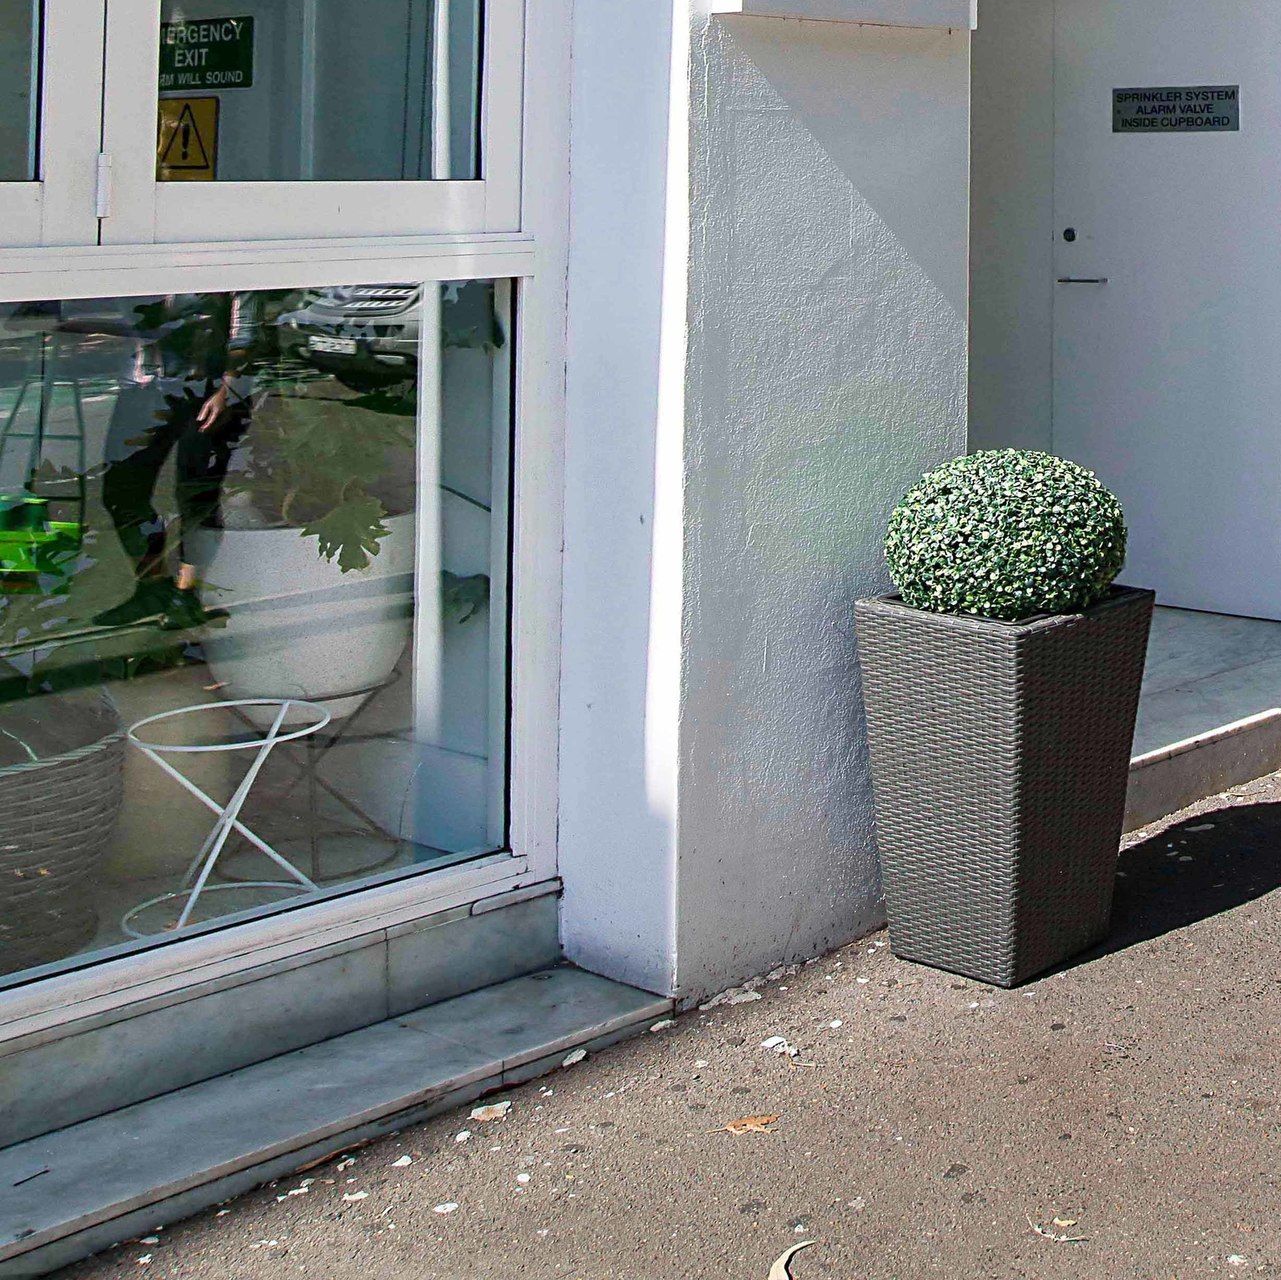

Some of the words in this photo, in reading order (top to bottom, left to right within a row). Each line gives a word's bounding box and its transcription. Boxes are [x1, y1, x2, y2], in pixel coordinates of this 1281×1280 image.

[175, 48, 208, 67] EXIT
[178, 72, 201, 85] WILL
[206, 70, 243, 83] SOUND
[1116, 92, 1182, 103] SPRINKLER
[1185, 91, 1235, 101] SYSTEM
[1136, 104, 1176, 114] ALARM
[1178, 103, 1214, 114] VALVE
[1121, 117, 1158, 127] INSIDE
[1161, 116, 1230, 127] CUPBOARD
